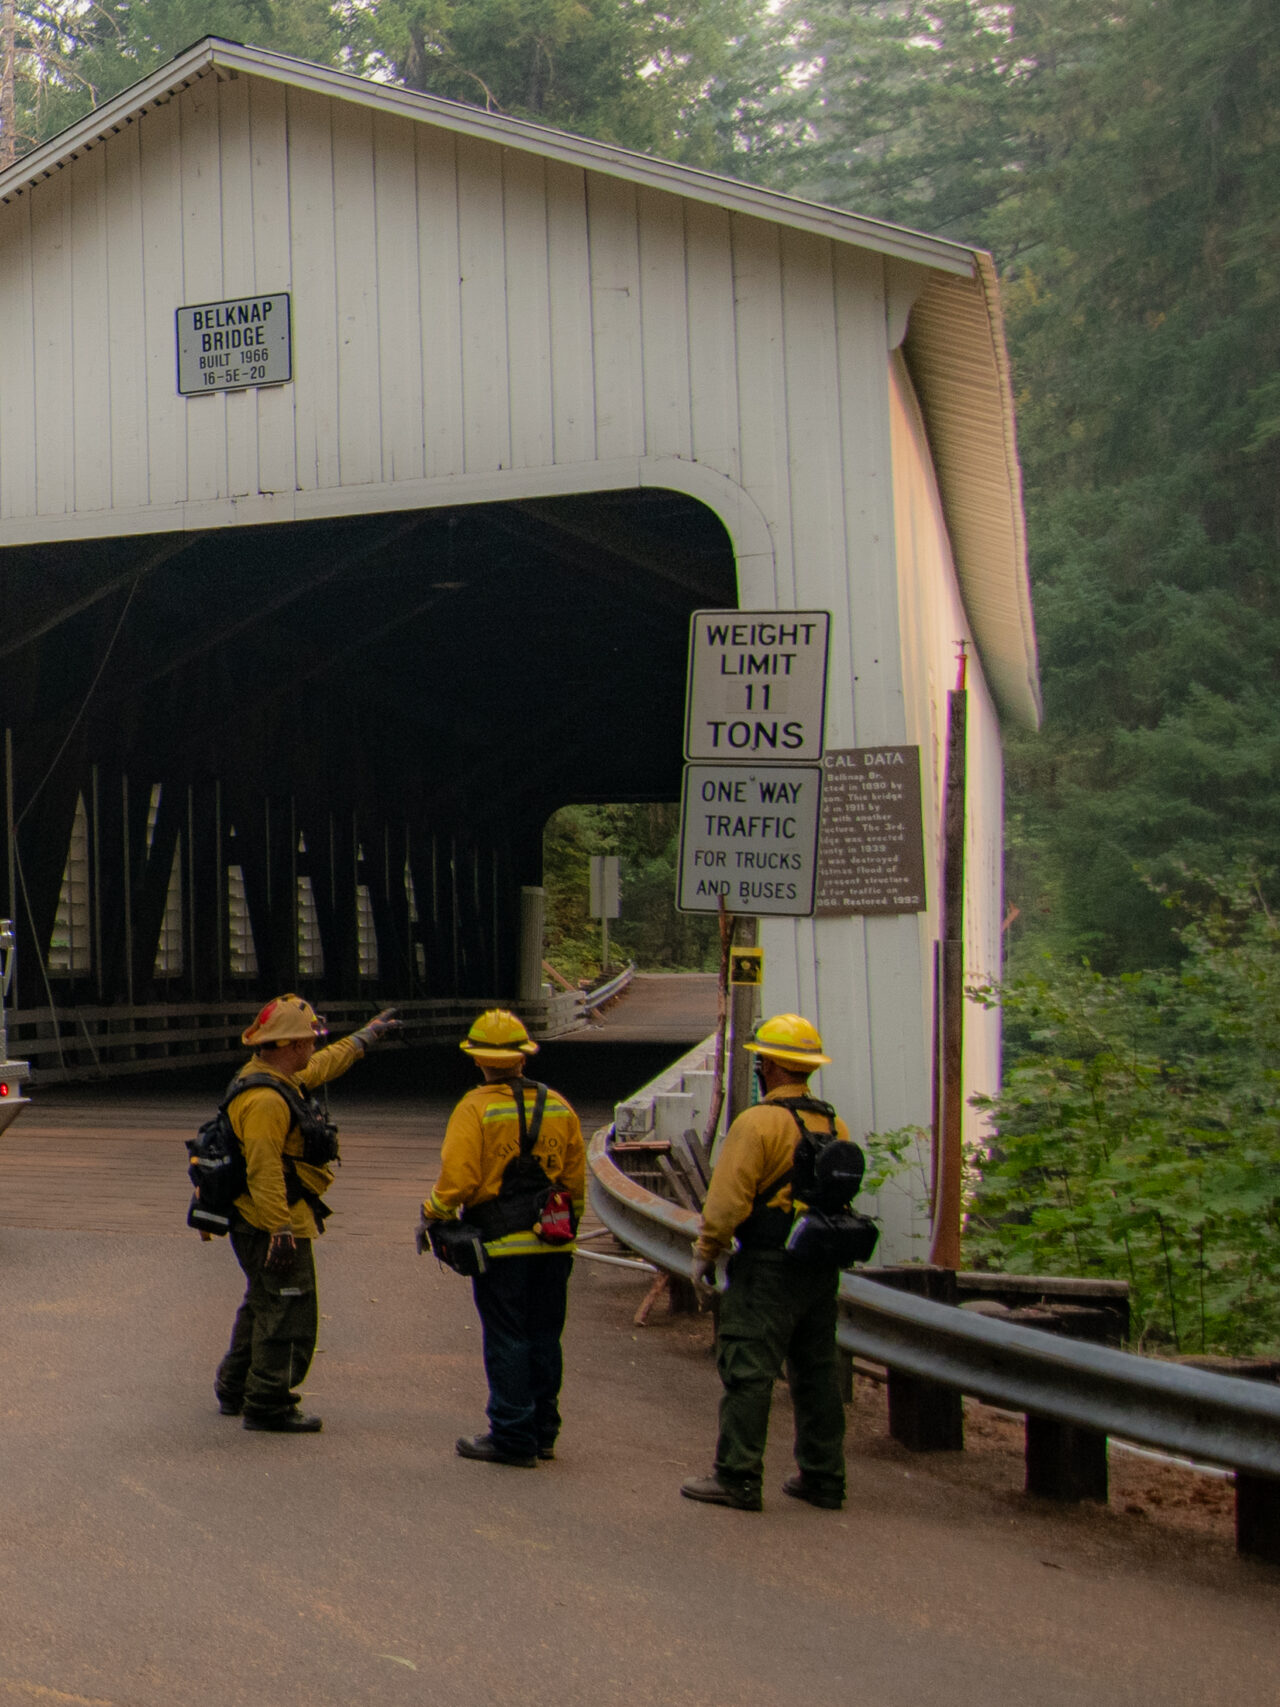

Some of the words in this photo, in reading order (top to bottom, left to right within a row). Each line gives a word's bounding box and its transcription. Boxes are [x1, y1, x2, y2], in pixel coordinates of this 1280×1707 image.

[193, 301, 272, 331] BELKNAP
[202, 325, 265, 352] BRIDGE
[199, 353, 231, 369] BUILT
[240, 348, 269, 364] 1966
[203, 365, 266, 386] 16-5E-20
[706, 623, 817, 646] WEIGHT
[721, 653, 797, 676] LIMIT
[744, 683, 771, 710] 11
[706, 721, 804, 749] TONS
[823, 755, 856, 768] CAL
[863, 752, 904, 766] DATA
[827, 773, 865, 782] Belknap
[701, 780, 747, 803] ONE
[759, 782, 803, 804] WAY
[823, 783, 845, 792] cted
[890, 781, 902, 790] by
[848, 793, 868, 801] This
[871, 792, 903, 802] bridge
[868, 803, 880, 812] by
[831, 814, 852, 822] with
[855, 813, 892, 822] another
[704, 815, 797, 839] TRAFFIC
[862, 823, 881, 832] The
[866, 833, 904, 842] erected
[694, 850, 726, 868] FOR
[736, 851, 801, 870] TRUCKS
[849, 854, 899, 864] destroyed
[886, 865, 897, 873] of
[864, 876, 909, 885] structure
[696, 880, 730, 897] AND
[739, 881, 797, 900] BUSES
[829, 888, 845, 896] for
[849, 887, 882, 895] traffic
[843, 896, 888, 906] Restored
